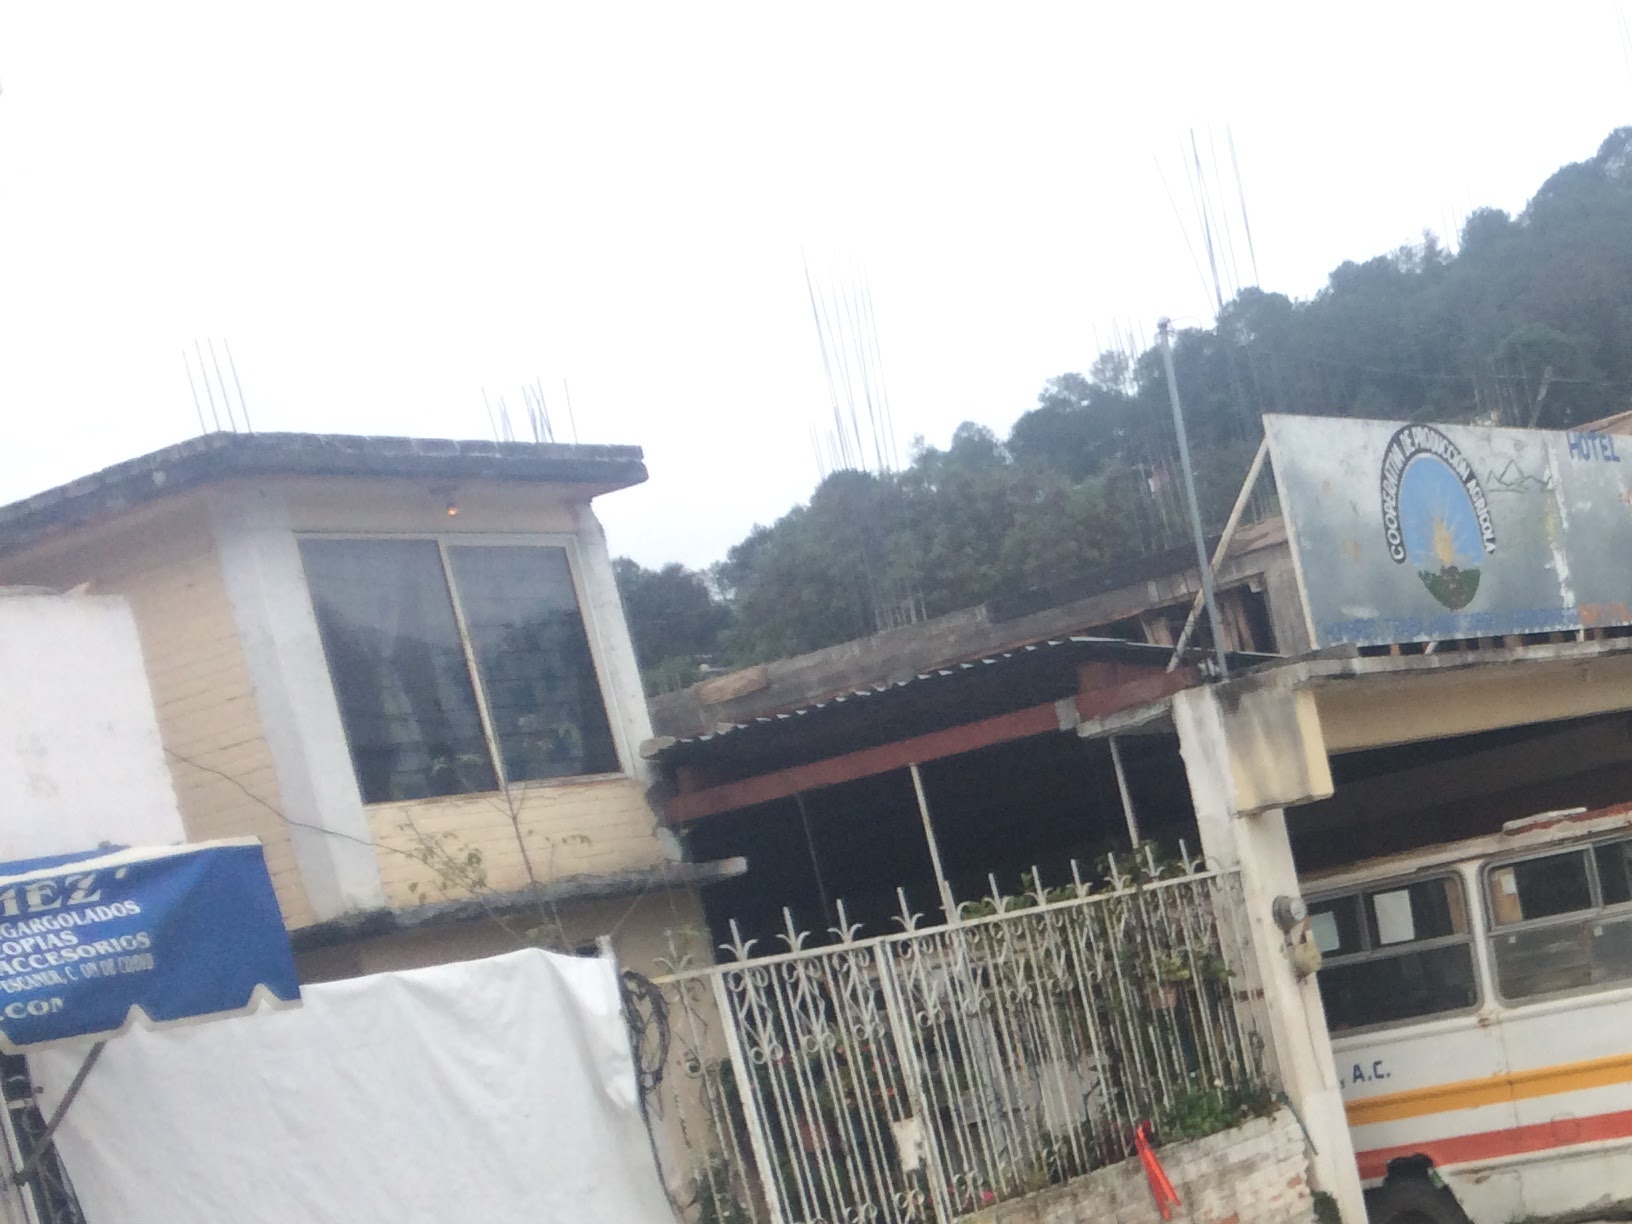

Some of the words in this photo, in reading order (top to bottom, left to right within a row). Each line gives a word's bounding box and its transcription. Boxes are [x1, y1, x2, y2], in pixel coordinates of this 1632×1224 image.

[1566, 431, 1621, 463] HOTEL
[1466, 479, 1496, 552] AGRICOLA
[0, 901, 141, 940] GARGOLADOS
[0, 930, 79, 957] OPIAS
[1352, 1060, 1391, 1083] A.C.
